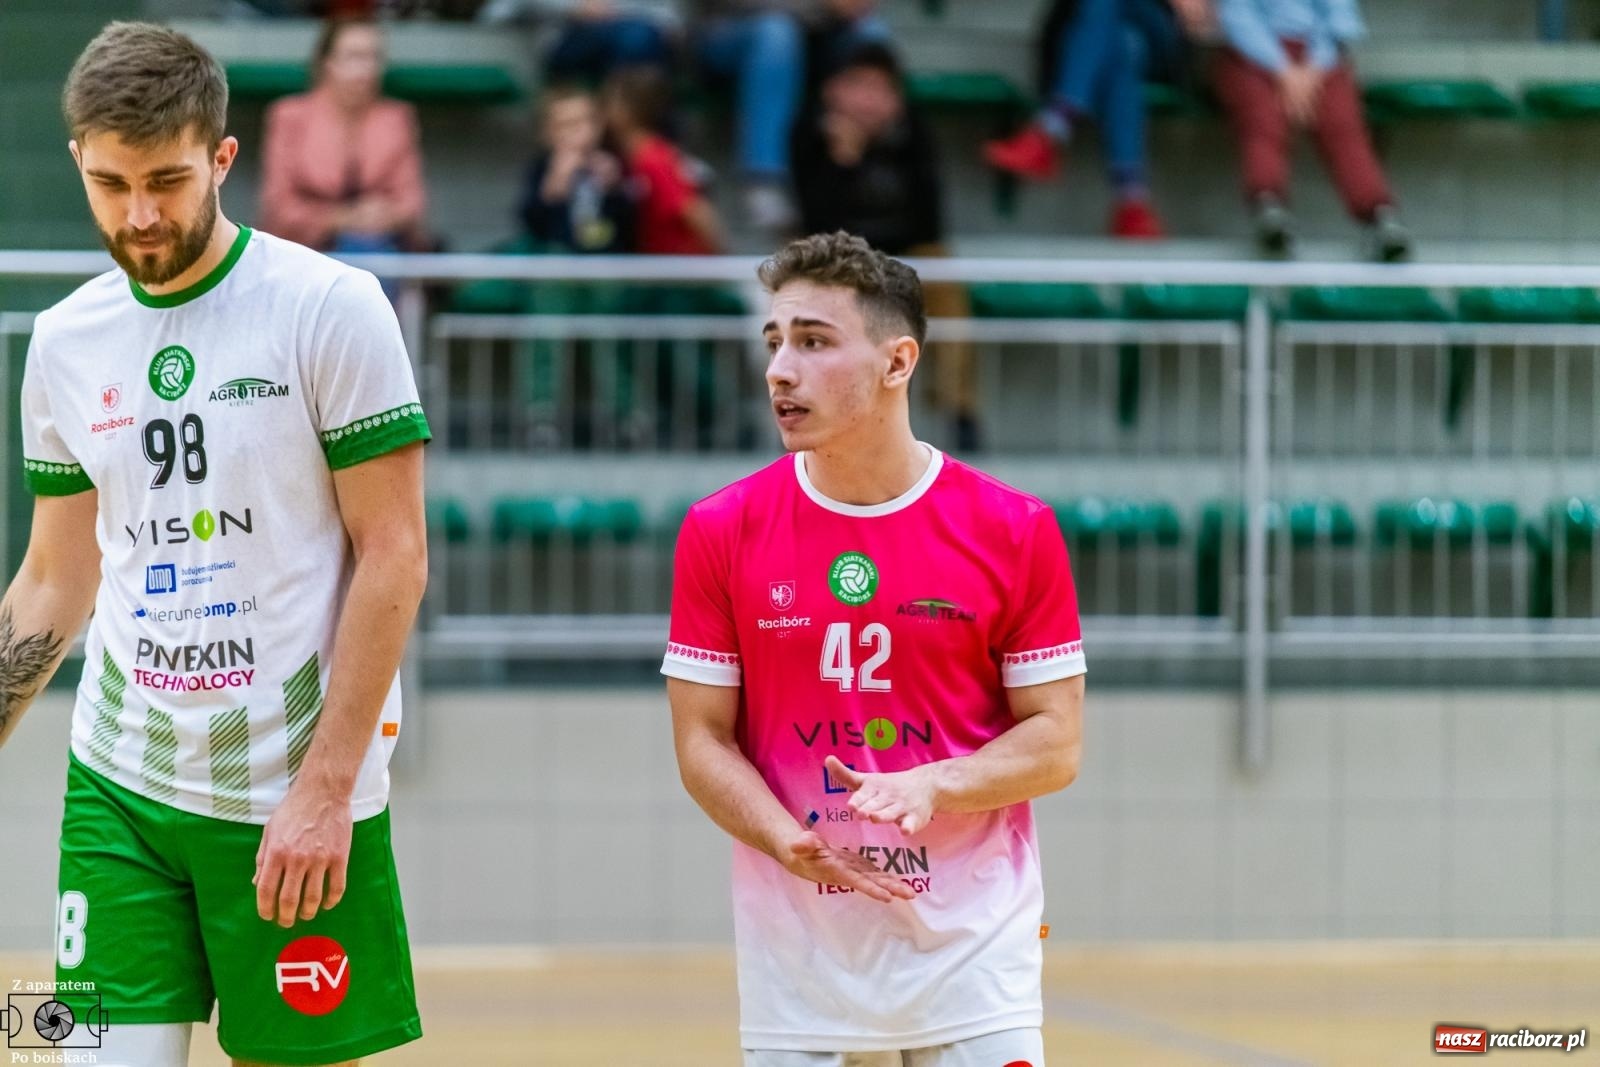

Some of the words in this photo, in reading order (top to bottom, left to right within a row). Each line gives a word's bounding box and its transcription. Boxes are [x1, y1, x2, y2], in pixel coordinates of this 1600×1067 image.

[142, 413, 207, 489] 98
[125, 508, 252, 547] VISON
[758, 616, 811, 629] Racibórz
[820, 623, 893, 692] 42
[133, 669, 254, 692] TECHNOLOGY
[793, 718, 931, 750] VISON
